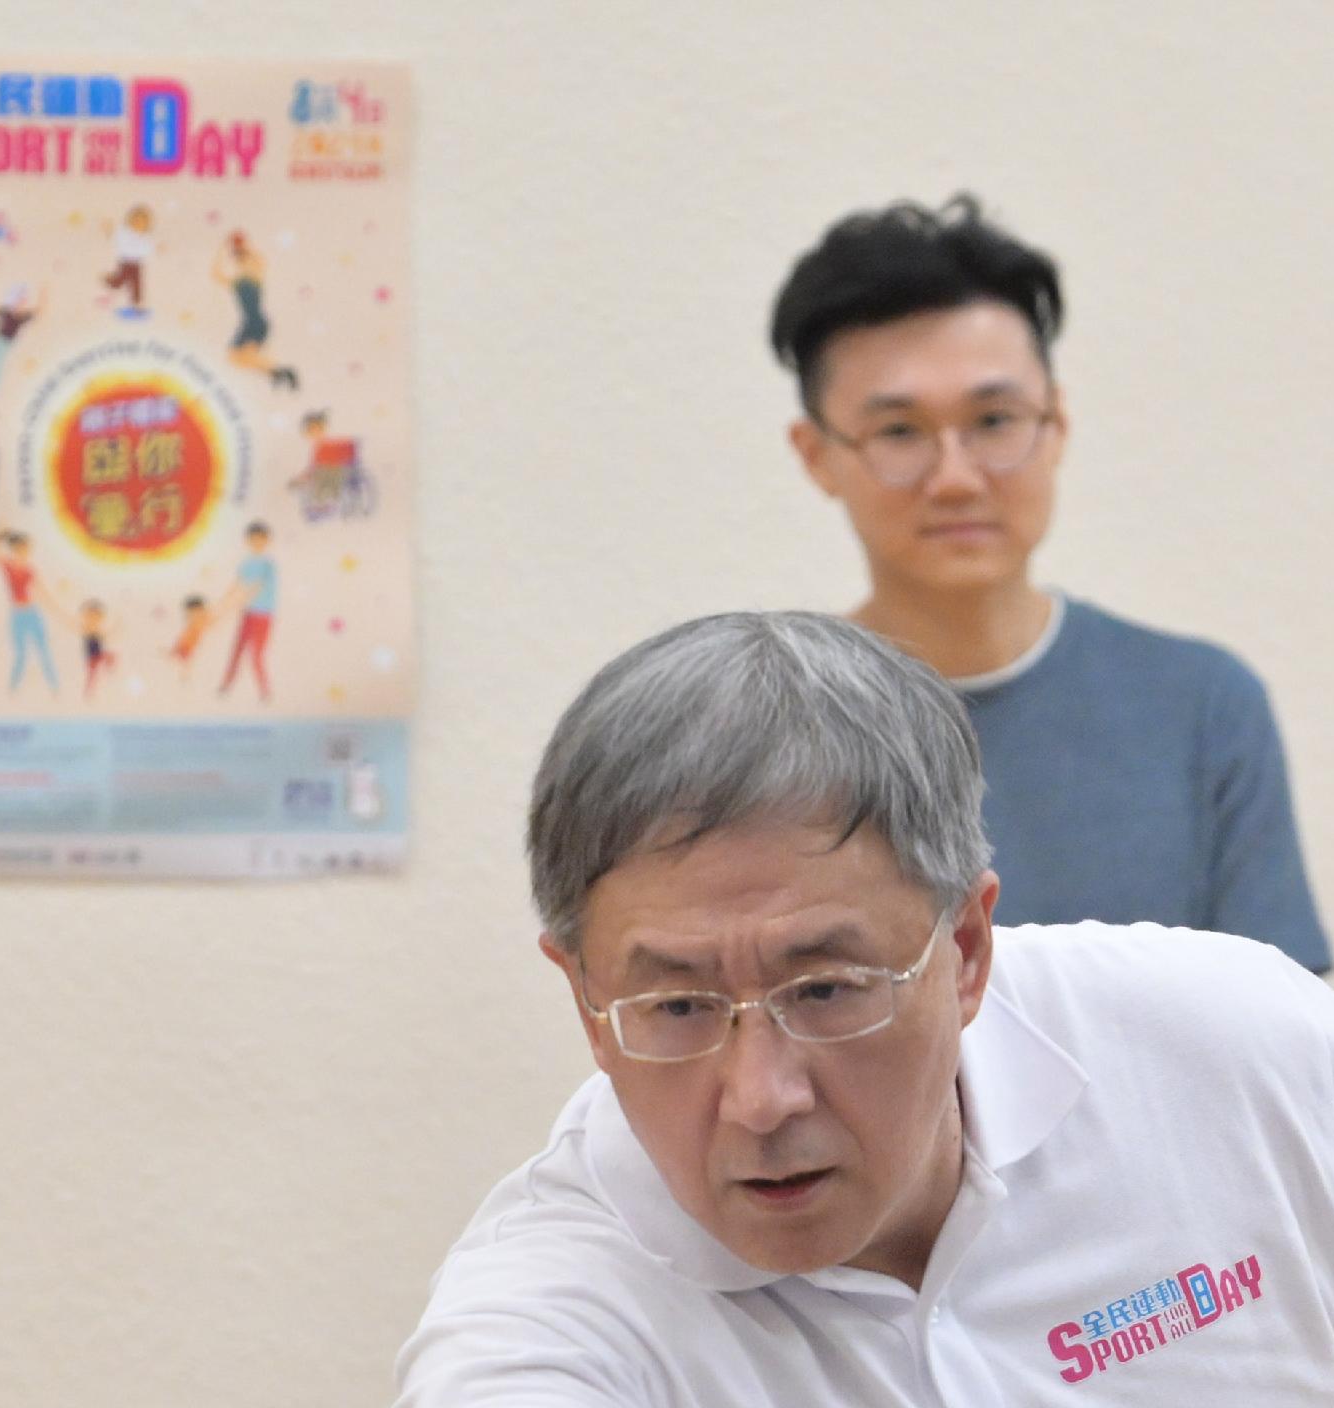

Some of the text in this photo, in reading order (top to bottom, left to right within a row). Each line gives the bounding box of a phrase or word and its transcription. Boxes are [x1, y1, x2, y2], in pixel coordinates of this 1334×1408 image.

[132, 78, 265, 178] DAY
[1047, 1255, 1262, 1383] SPORT FOR ALL DAY
